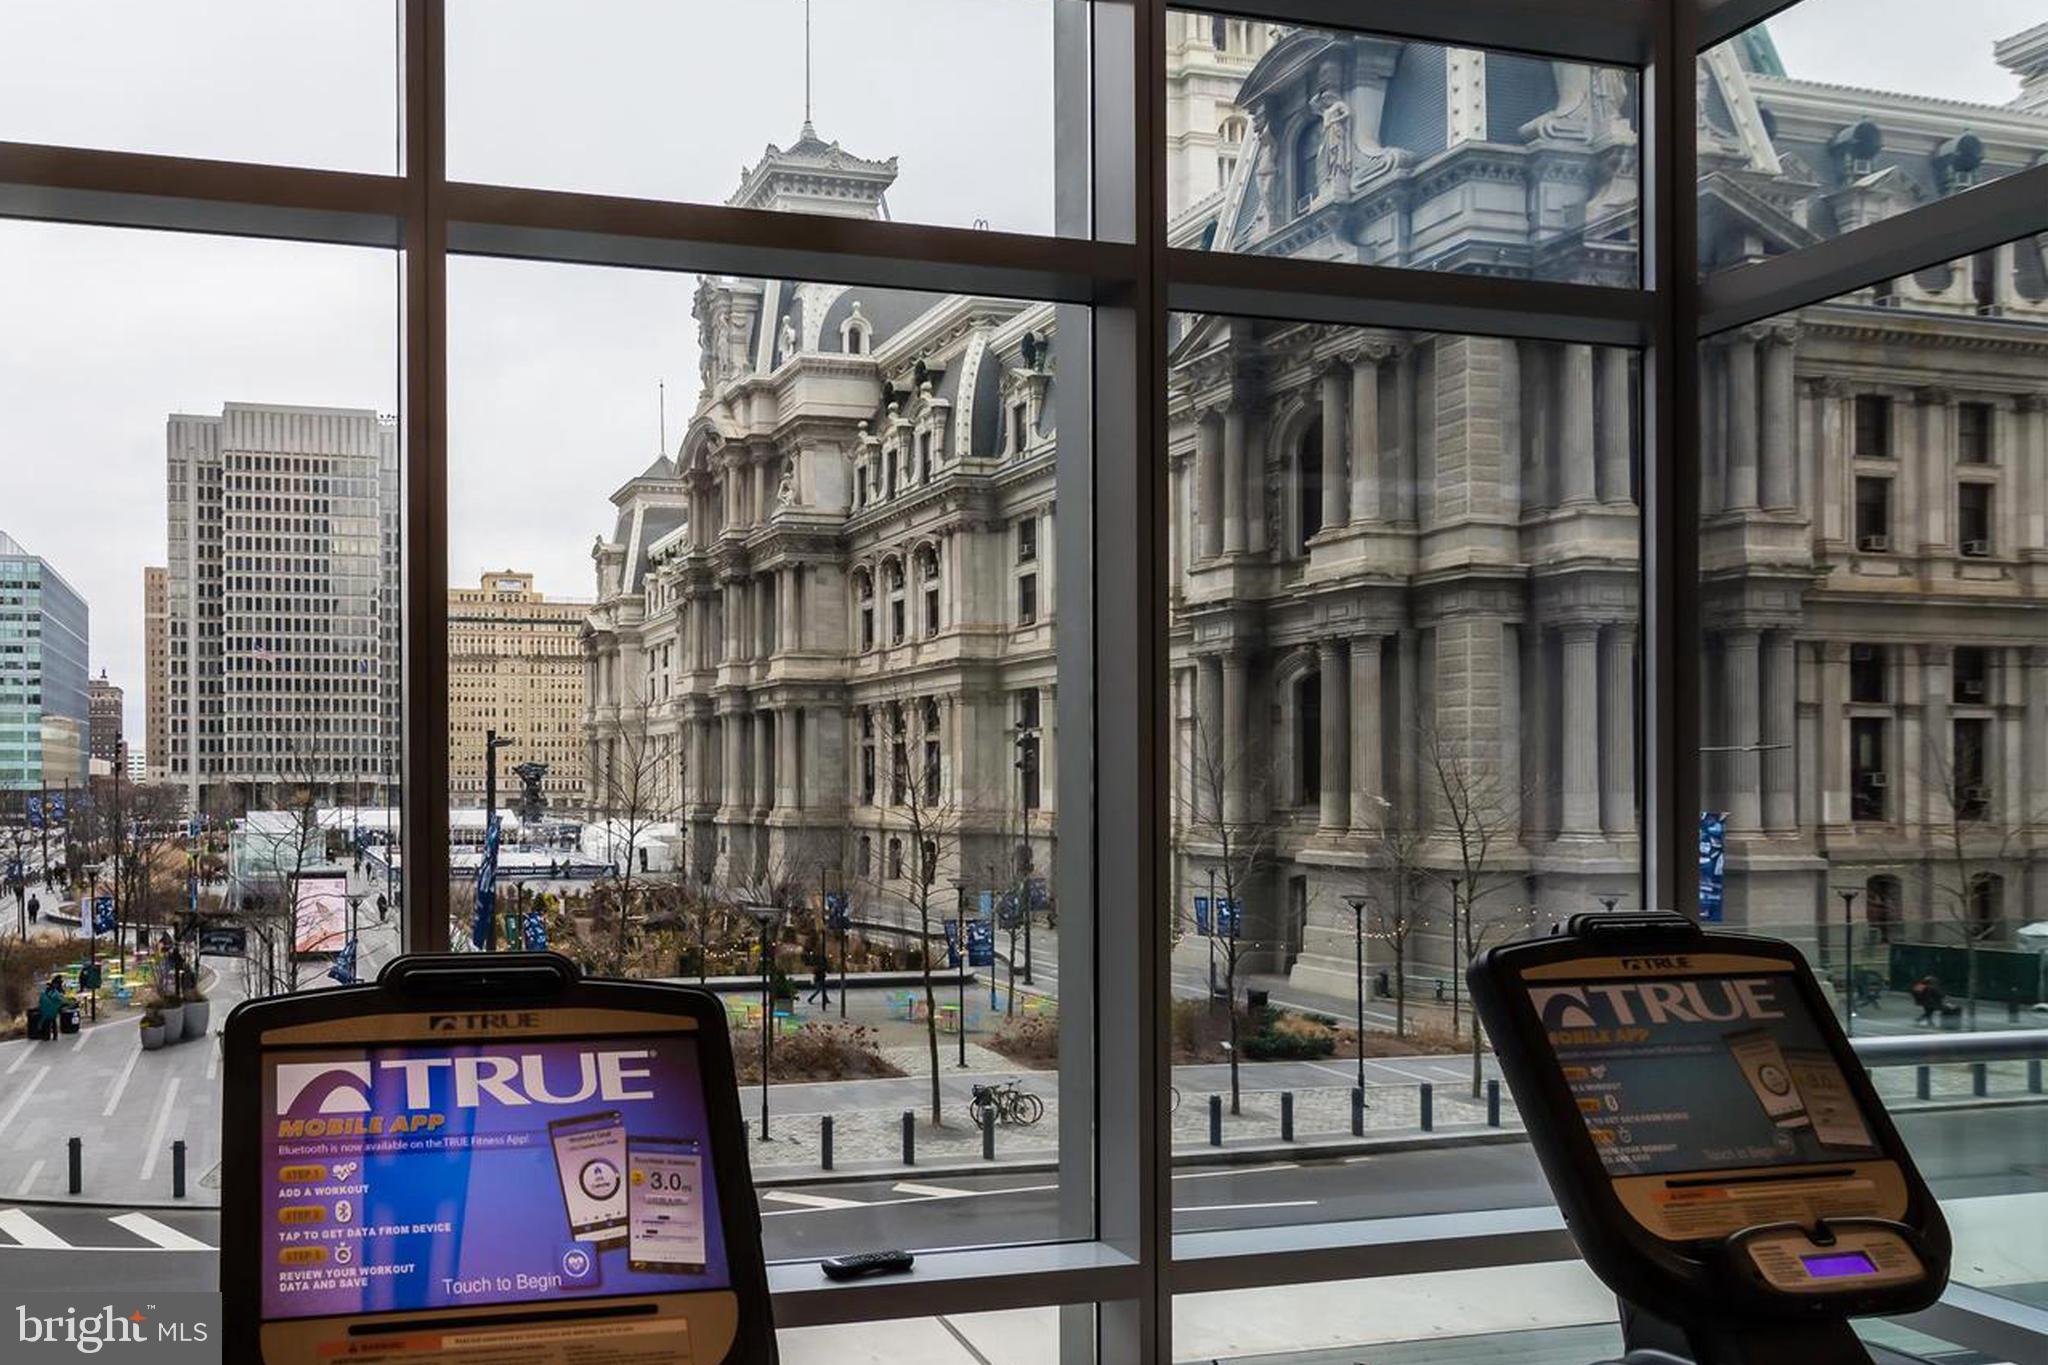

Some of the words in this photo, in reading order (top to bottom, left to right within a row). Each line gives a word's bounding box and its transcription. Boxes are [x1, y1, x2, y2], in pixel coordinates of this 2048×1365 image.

[1644, 956, 1692, 970] TRUE
[1588, 979, 1785, 1025] TRUE
[463, 1013, 539, 1029] TRUE
[380, 1050, 655, 1111] TRUE
[278, 1115, 384, 1138] MOBILE
[389, 1113, 446, 1134] APP
[279, 1143, 329, 1156] Bluetooth
[329, 1144, 339, 1154] is
[340, 1144, 363, 1153] now
[366, 1138, 408, 1152] available
[410, 1140, 424, 1150] on
[425, 1137, 443, 1149] the
[443, 1136, 469, 1147] TRUE
[471, 1134, 504, 1147] Fitness
[506, 1133, 531, 1147] App!
[279, 1188, 301, 1198] ADD
[304, 1187, 312, 1196] A
[314, 1184, 369, 1196] WORKOUT
[650, 1172, 681, 1191] 3.0
[279, 1231, 301, 1241] TAP
[303, 1230, 319, 1240] TO
[322, 1229, 343, 1239] GET
[347, 1226, 377, 1238] DATA
[379, 1224, 410, 1236] FROM
[412, 1222, 452, 1234] DEVICE
[279, 1270, 323, 1281] REVIEW
[325, 1267, 356, 1278] YOUR
[359, 1263, 415, 1276] WORKOUT
[279, 1281, 310, 1292] DATA
[313, 1279, 337, 1290] AND
[339, 1276, 368, 1288] SAVE
[442, 1276, 492, 1295] Touch
[496, 1276, 512, 1291] to
[516, 1272, 562, 1292] Begin
